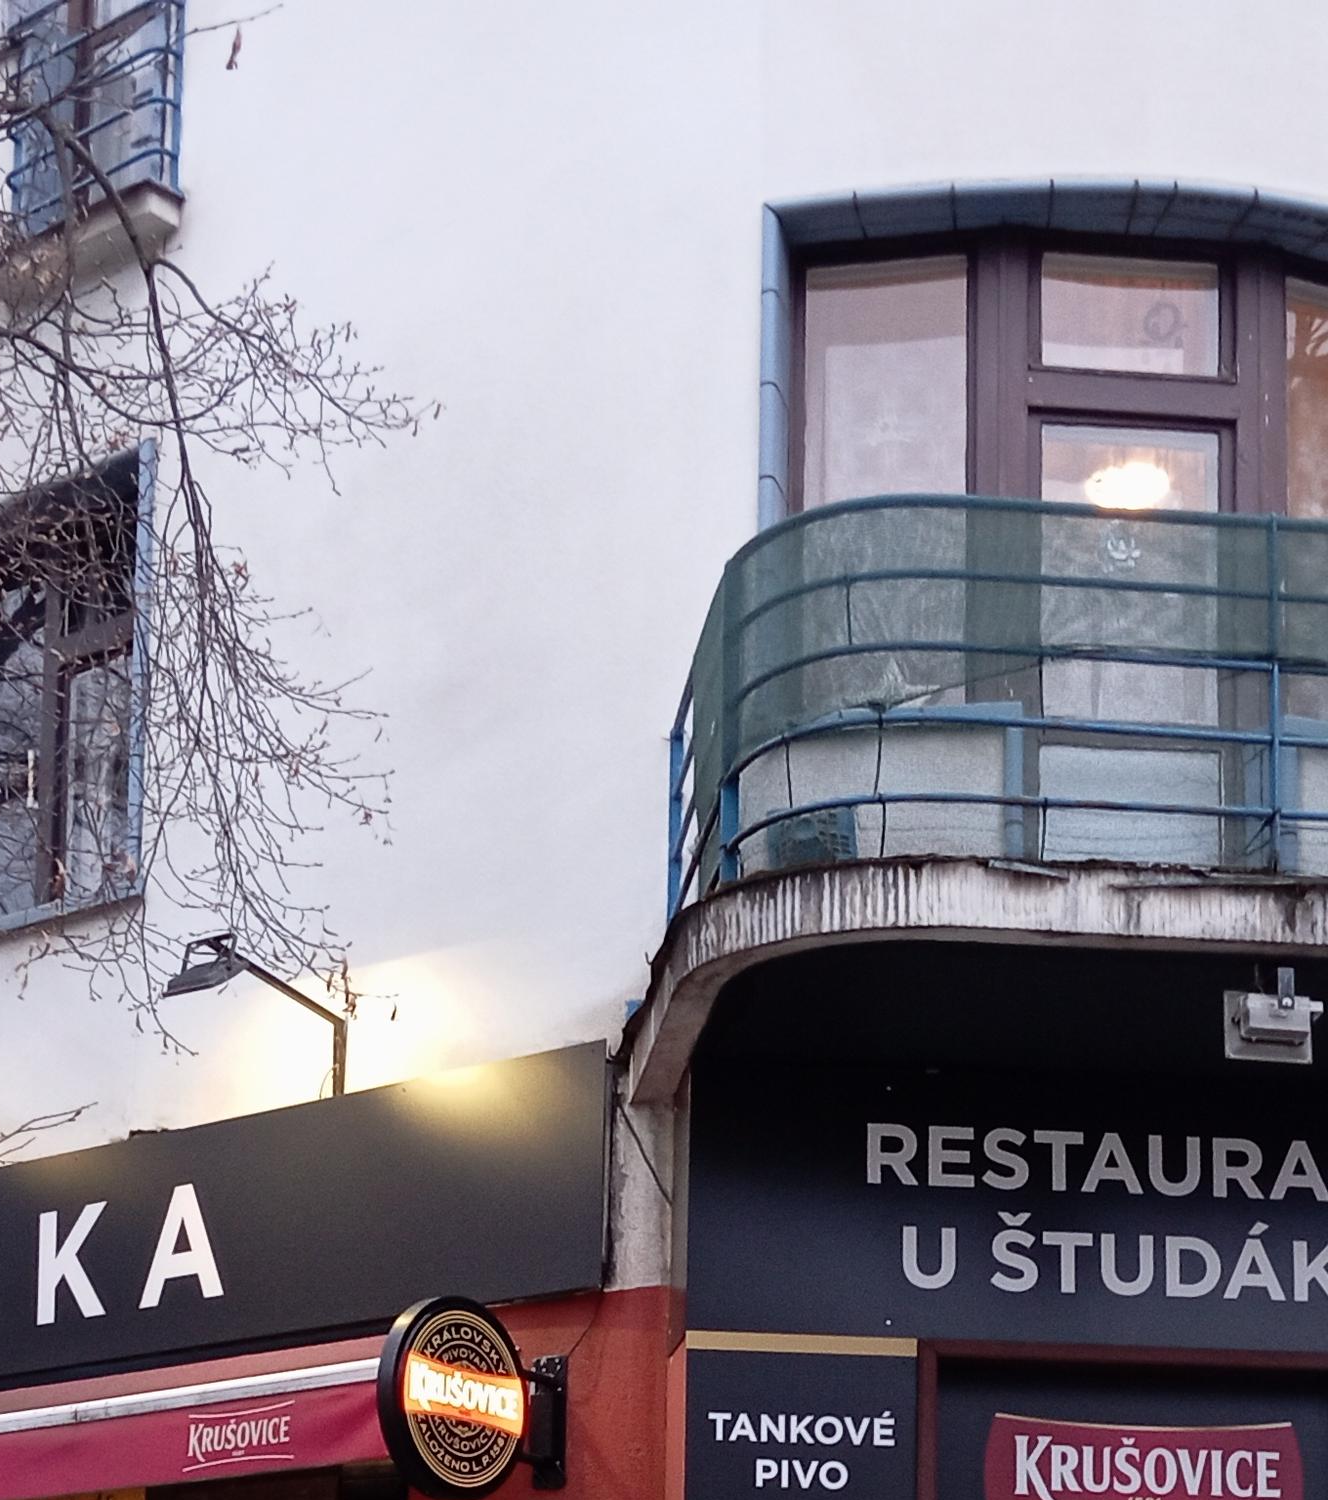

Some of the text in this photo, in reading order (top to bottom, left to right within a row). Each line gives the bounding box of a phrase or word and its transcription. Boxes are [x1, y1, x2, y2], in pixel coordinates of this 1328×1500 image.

[901, 1226, 957, 1290] U
[187, 1416, 291, 1463] KRUŠOVICE
[708, 1410, 895, 1448] TANKOVÉ
[754, 1458, 849, 1491] PIVO
